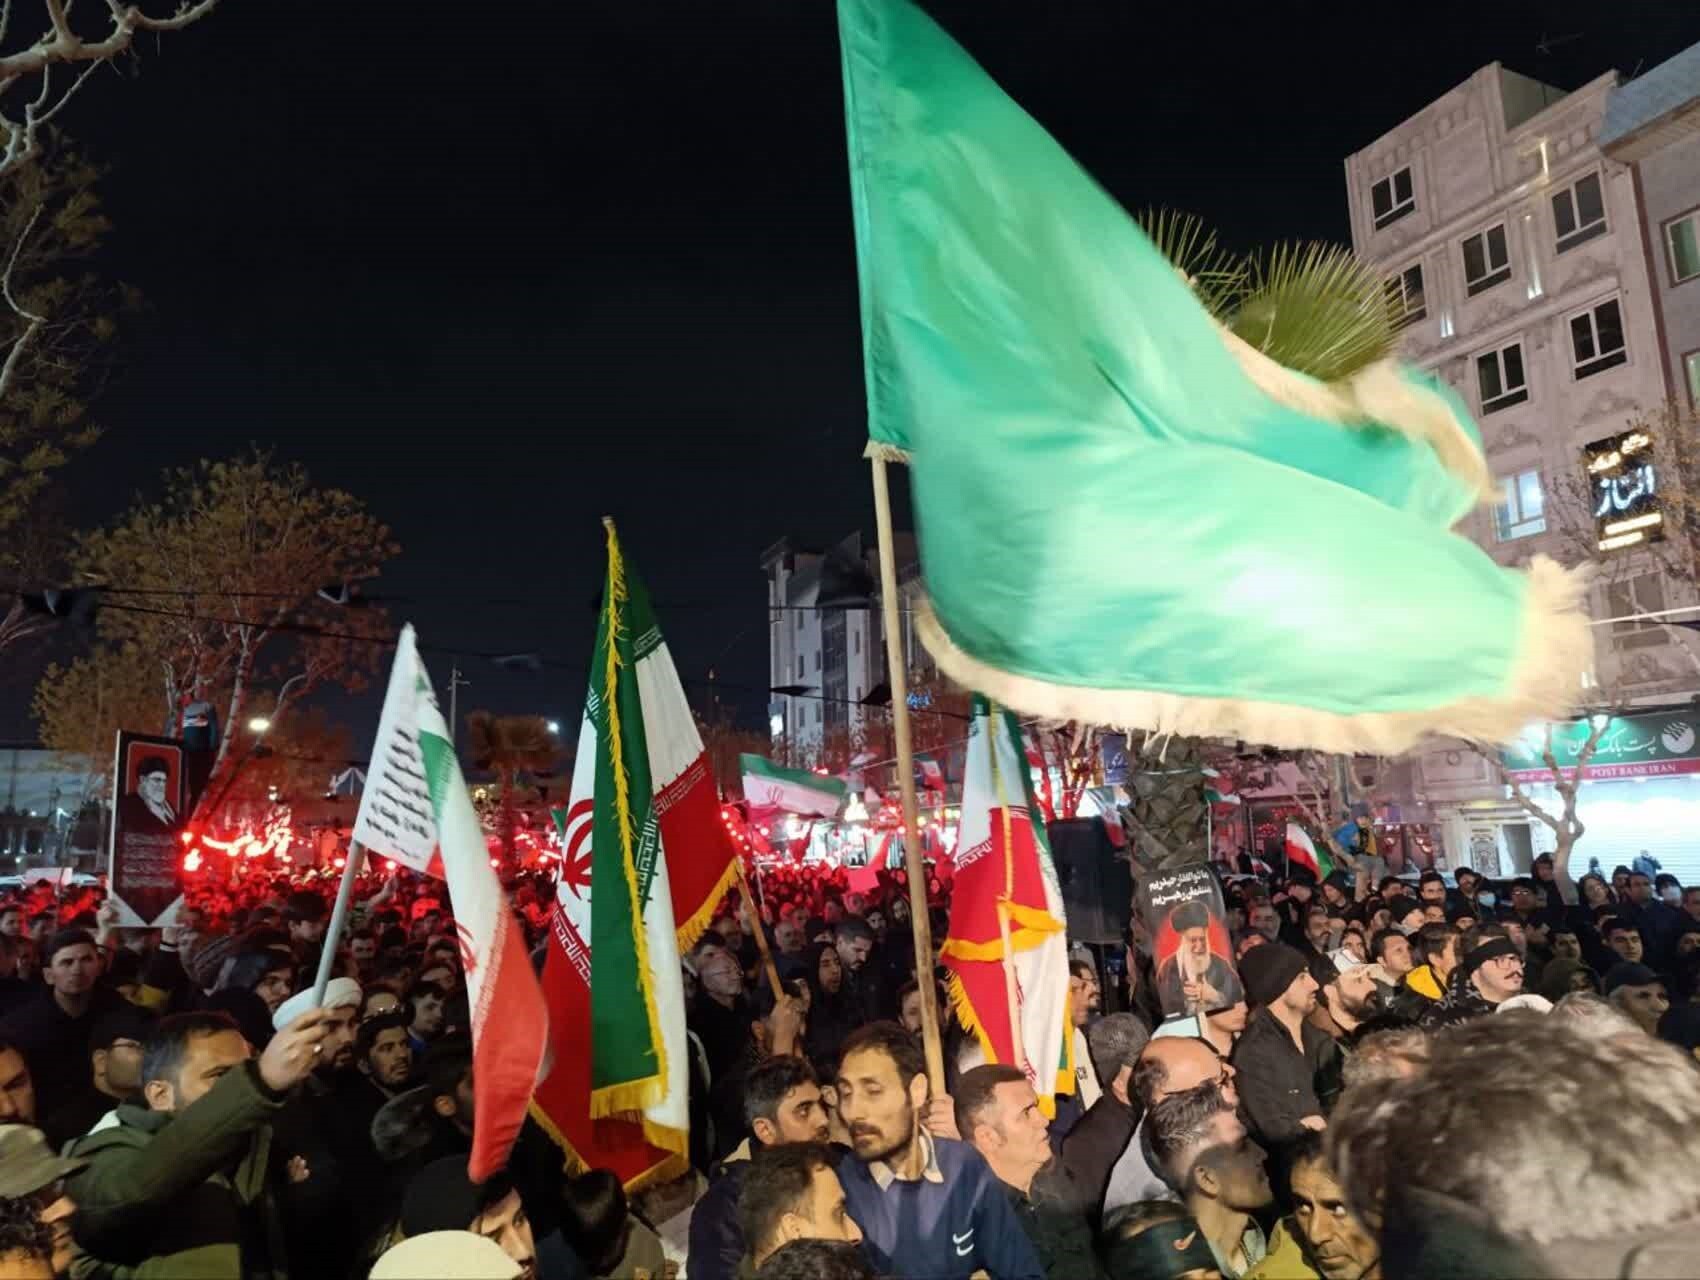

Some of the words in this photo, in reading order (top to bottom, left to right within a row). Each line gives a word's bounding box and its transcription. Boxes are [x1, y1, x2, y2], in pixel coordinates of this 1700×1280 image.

[1596, 727, 1627, 757] بانک
[1622, 736, 1656, 755] پست
[1591, 767, 1616, 777] POST
[1619, 766, 1648, 776] BANK
[1648, 764, 1676, 775] IRAN
